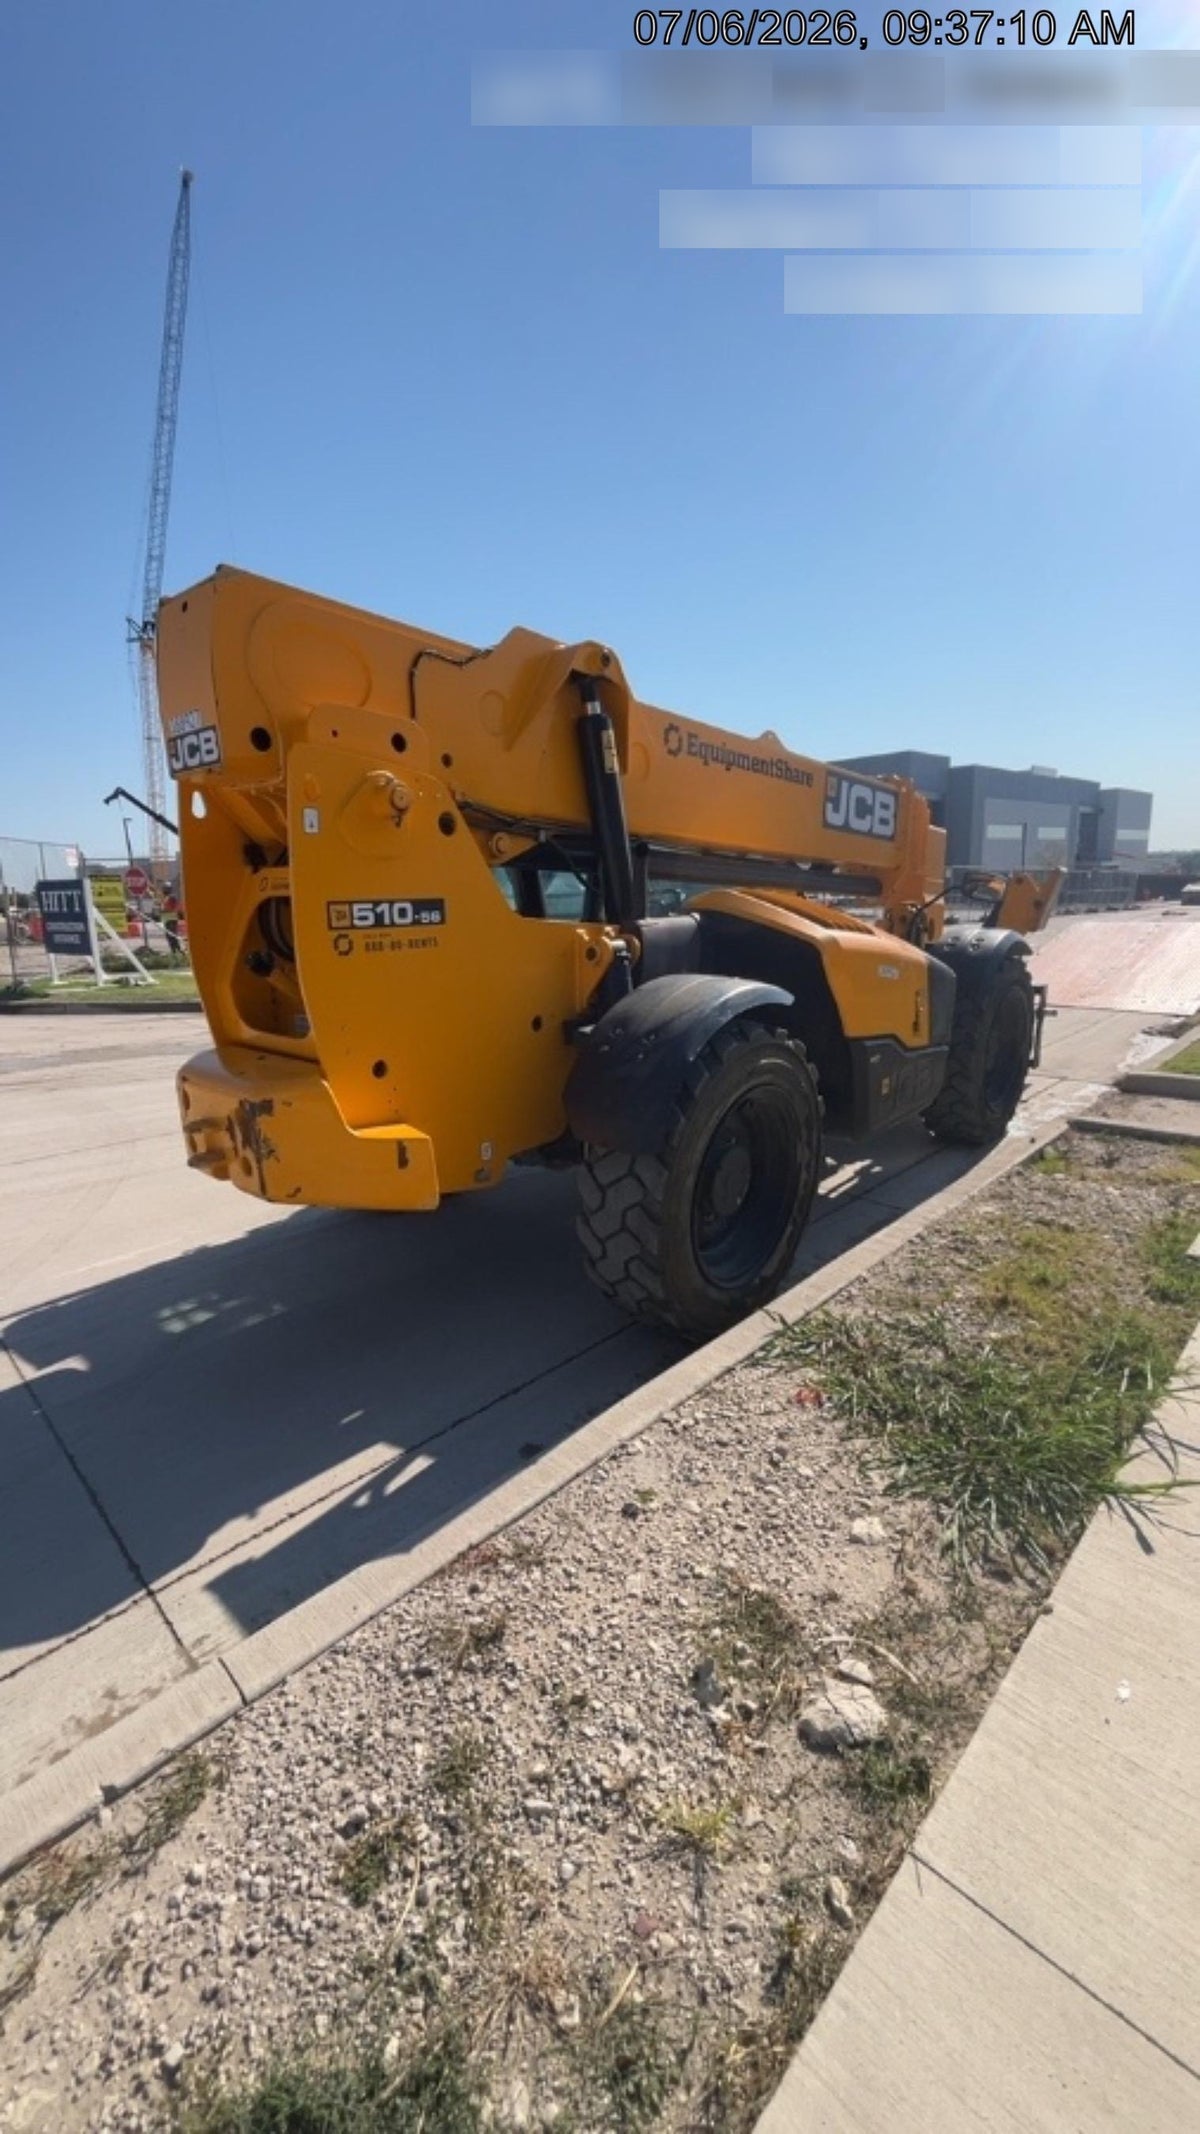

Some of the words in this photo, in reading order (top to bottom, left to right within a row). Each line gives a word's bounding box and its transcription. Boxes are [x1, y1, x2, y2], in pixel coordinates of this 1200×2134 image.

[171, 730, 219, 770] JCB
[687, 732, 814, 788] EquipmentShare
[825, 780, 895, 836] JCB
[40, 890, 81, 912] HITT
